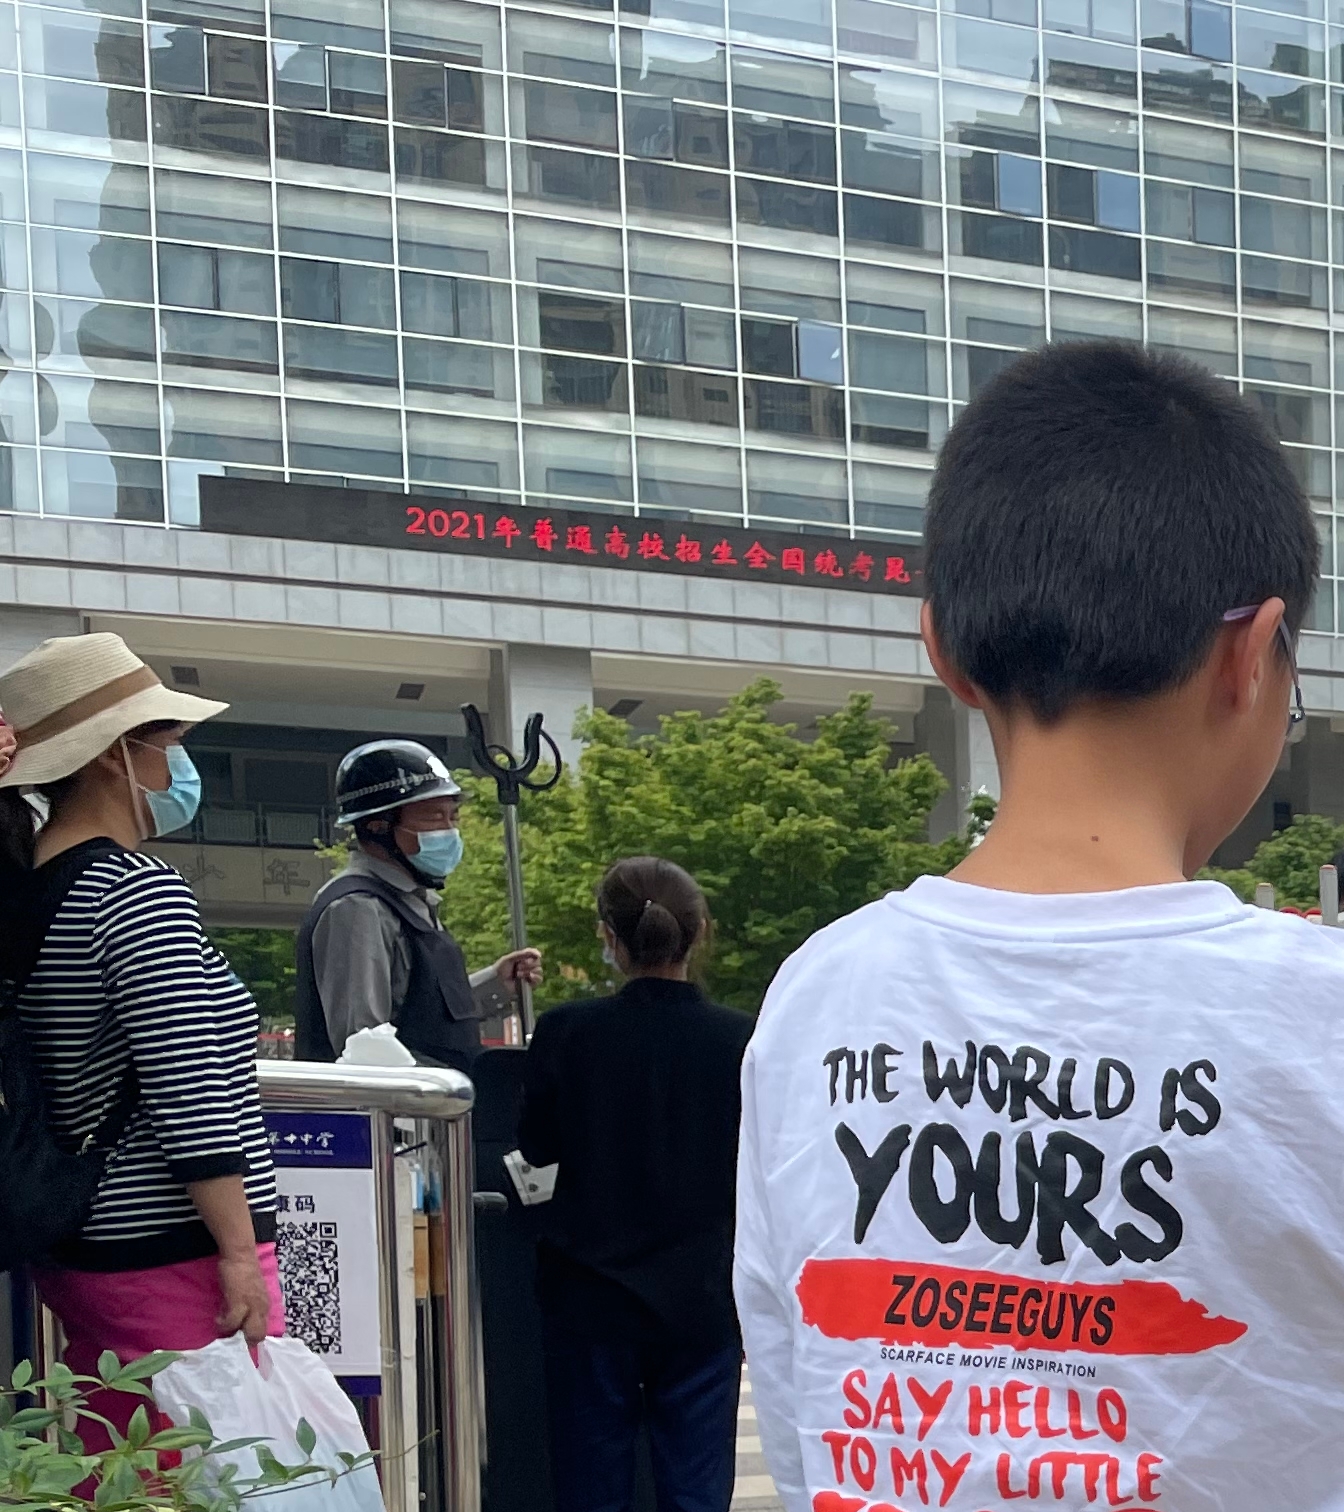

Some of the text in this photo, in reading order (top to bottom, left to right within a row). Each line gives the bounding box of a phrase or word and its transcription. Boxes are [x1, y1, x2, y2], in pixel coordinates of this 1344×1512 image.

[405, 506, 922, 583] 2021年普通高校招生全国统考昆
[823, 1040, 1223, 1137] THE WORLD IS
[834, 1121, 1185, 1267] YOURS
[883, 1274, 1116, 1347] ZOSEEGUYS
[880, 1347, 1097, 1378] SCARFACE MOVIE INSPIRATION
[840, 1368, 1128, 1443] SAY HELLO
[822, 1431, 1163, 1507] TO MY LITTLE
